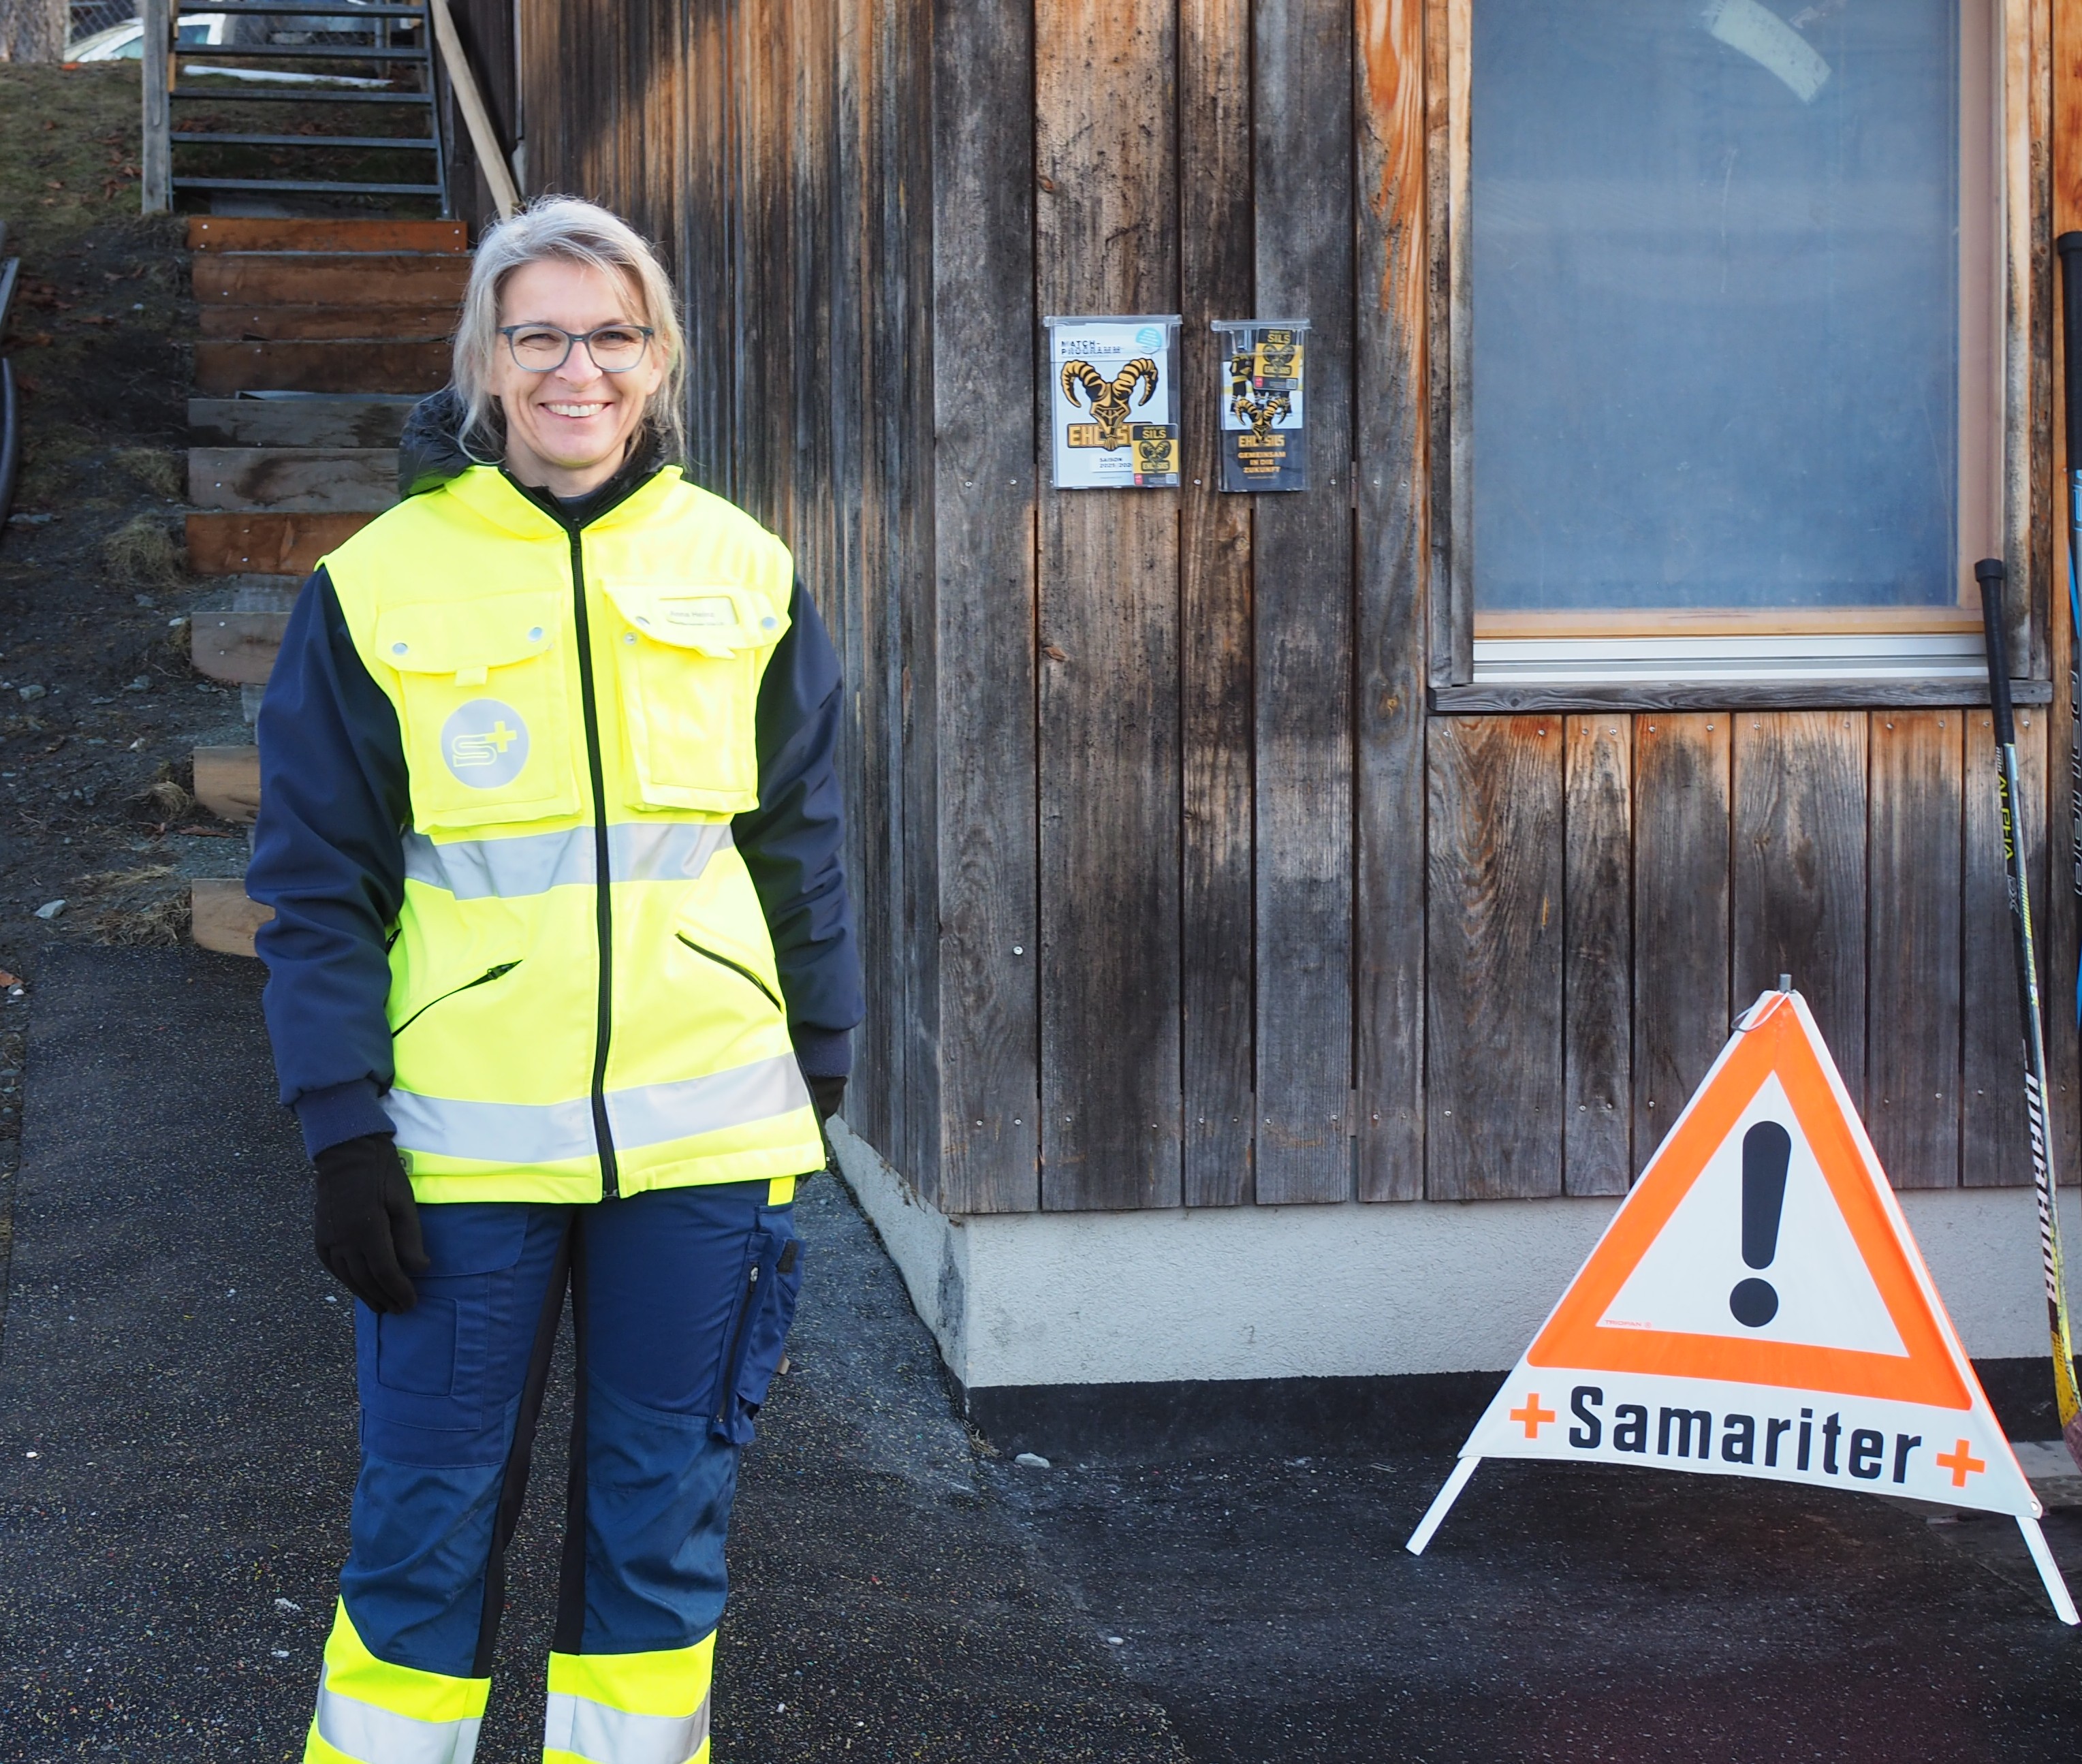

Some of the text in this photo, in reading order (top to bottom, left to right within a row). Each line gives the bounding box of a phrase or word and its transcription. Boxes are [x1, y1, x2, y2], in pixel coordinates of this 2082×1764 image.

[1267, 334, 1291, 343] SILS
[1069, 425, 1106, 446] EHC
[1142, 429, 1167, 439] SILS
[1998, 774, 2014, 862] ALPHA
[2024, 1071, 2058, 1304] WARRIOR
[1568, 1385, 1922, 1484] Samariter
